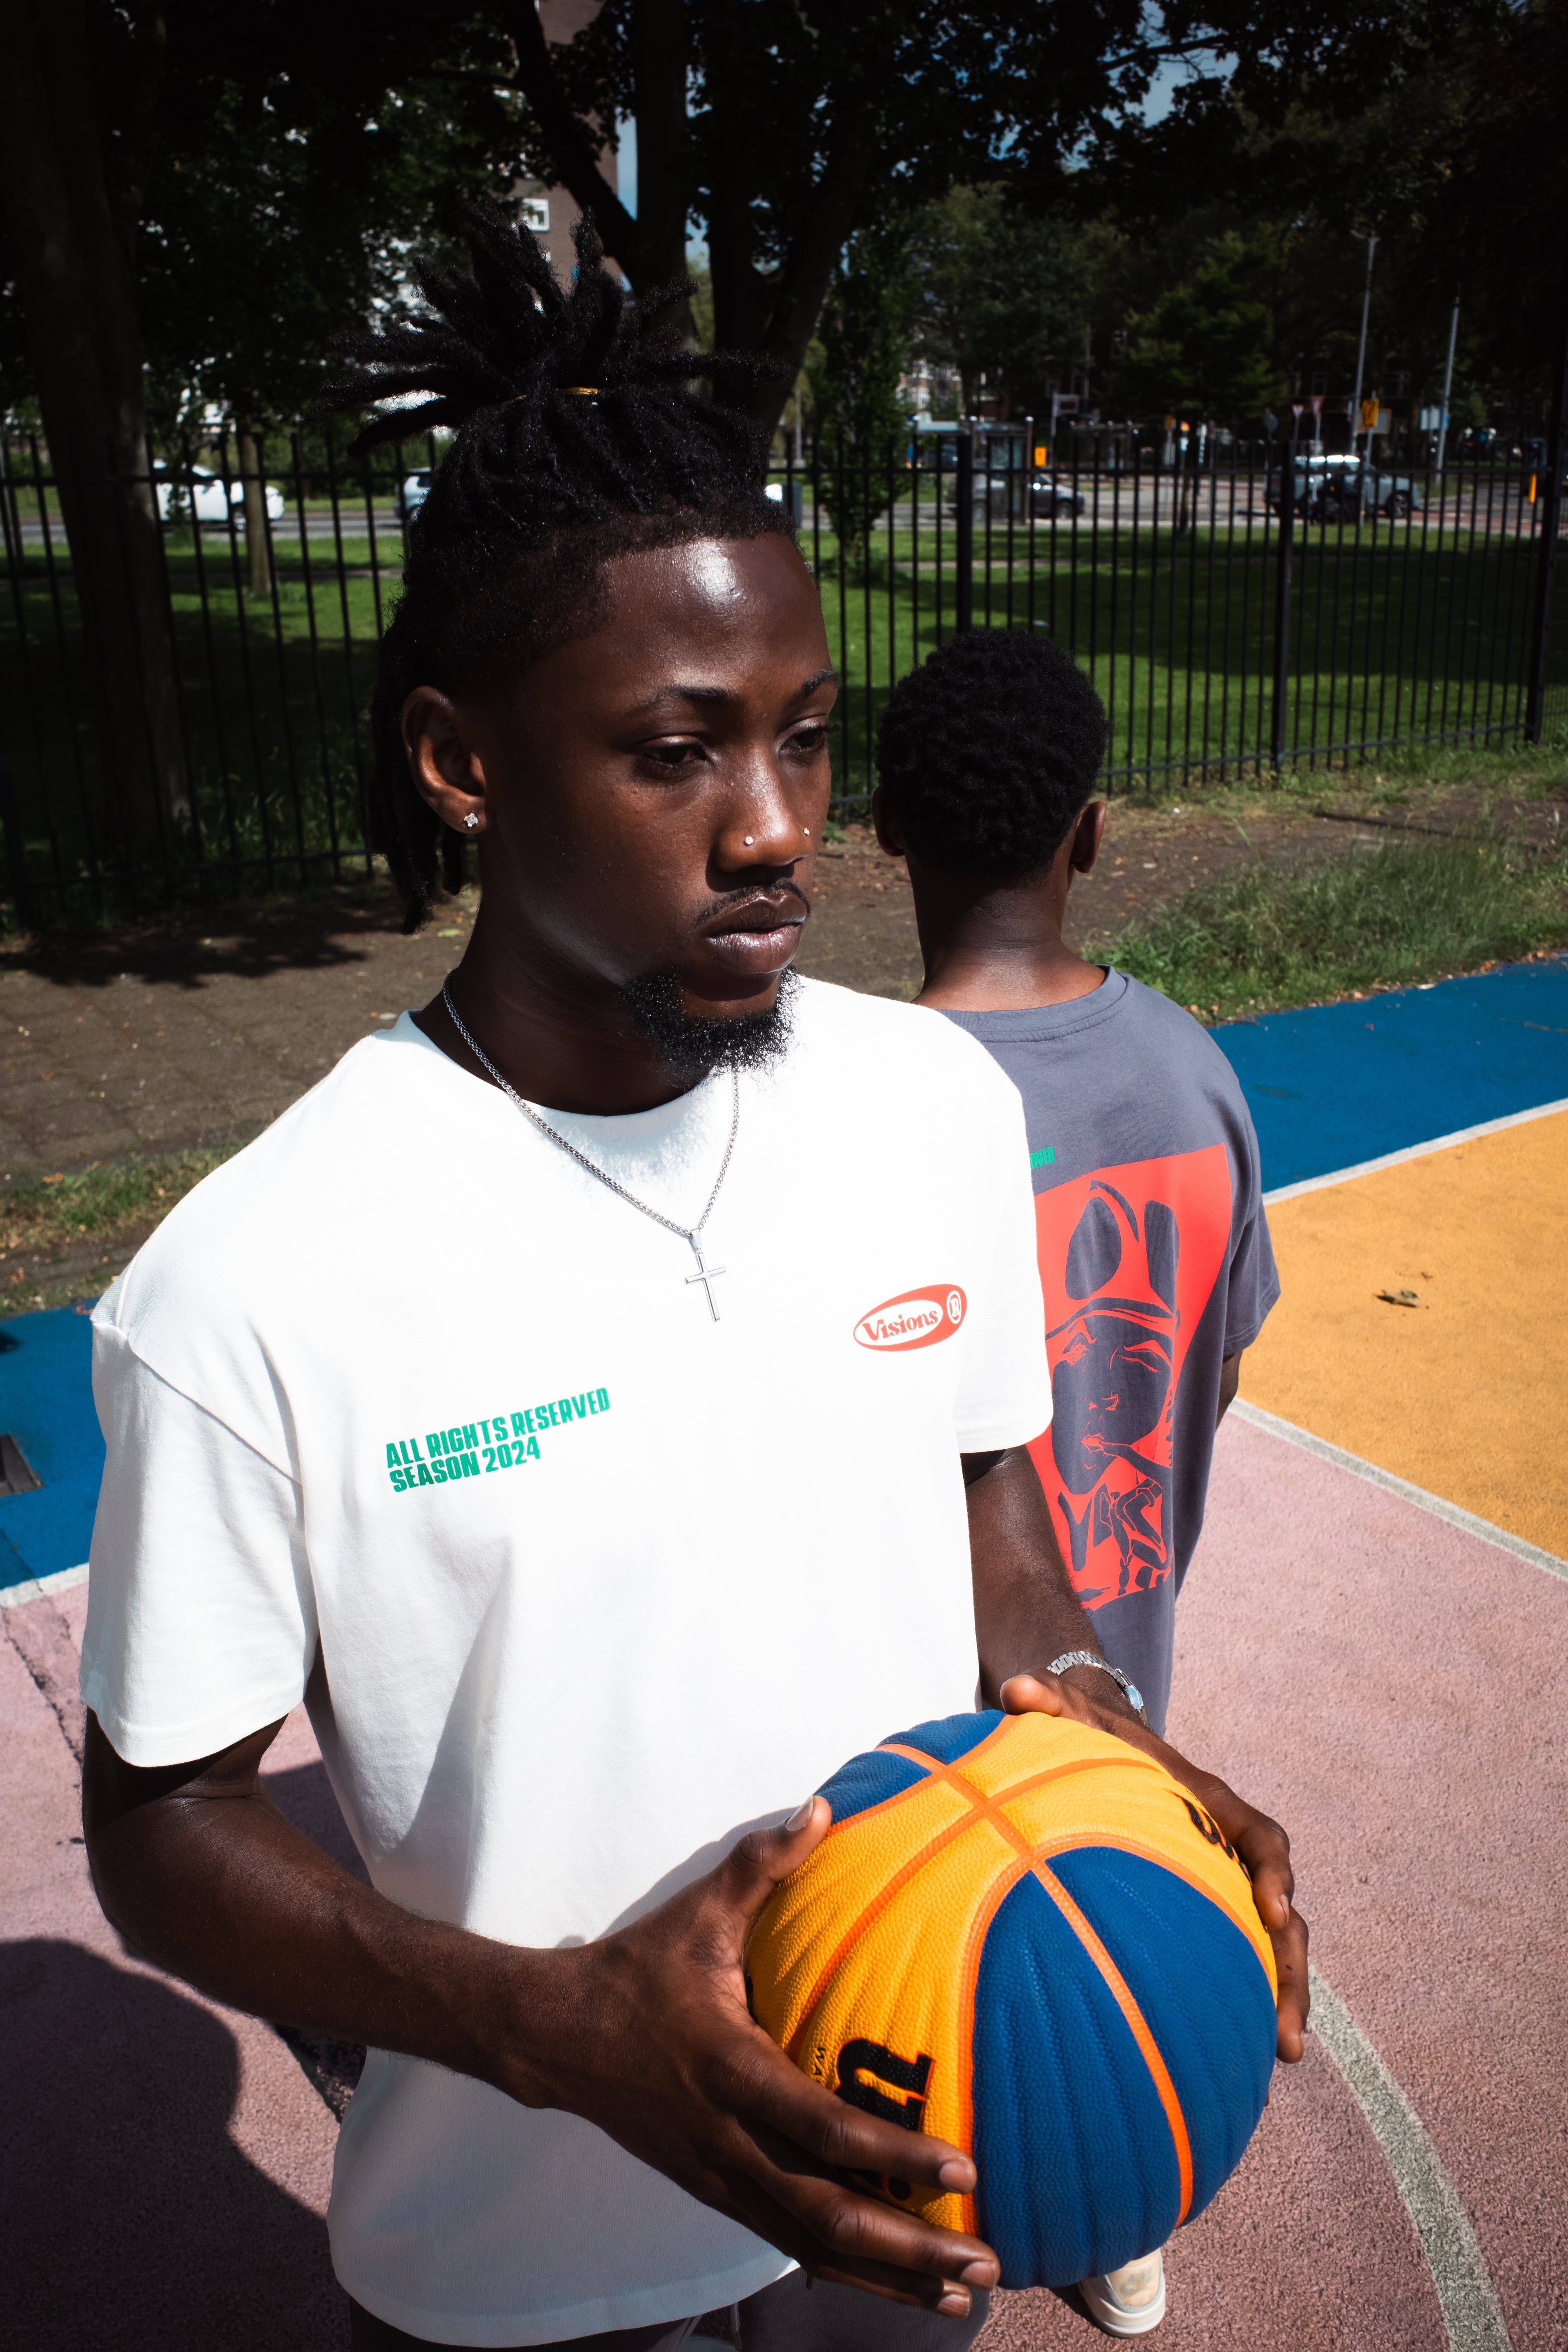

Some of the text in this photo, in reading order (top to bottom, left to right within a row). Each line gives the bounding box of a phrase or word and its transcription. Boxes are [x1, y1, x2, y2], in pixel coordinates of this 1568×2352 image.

[1029, 1147, 1056, 1169] RVED
[862, 1310, 938, 1341] Visions
[386, 1387, 610, 1468] ALL RIGHTS RESERVED
[389, 1435, 541, 1492] SEASON 2024
